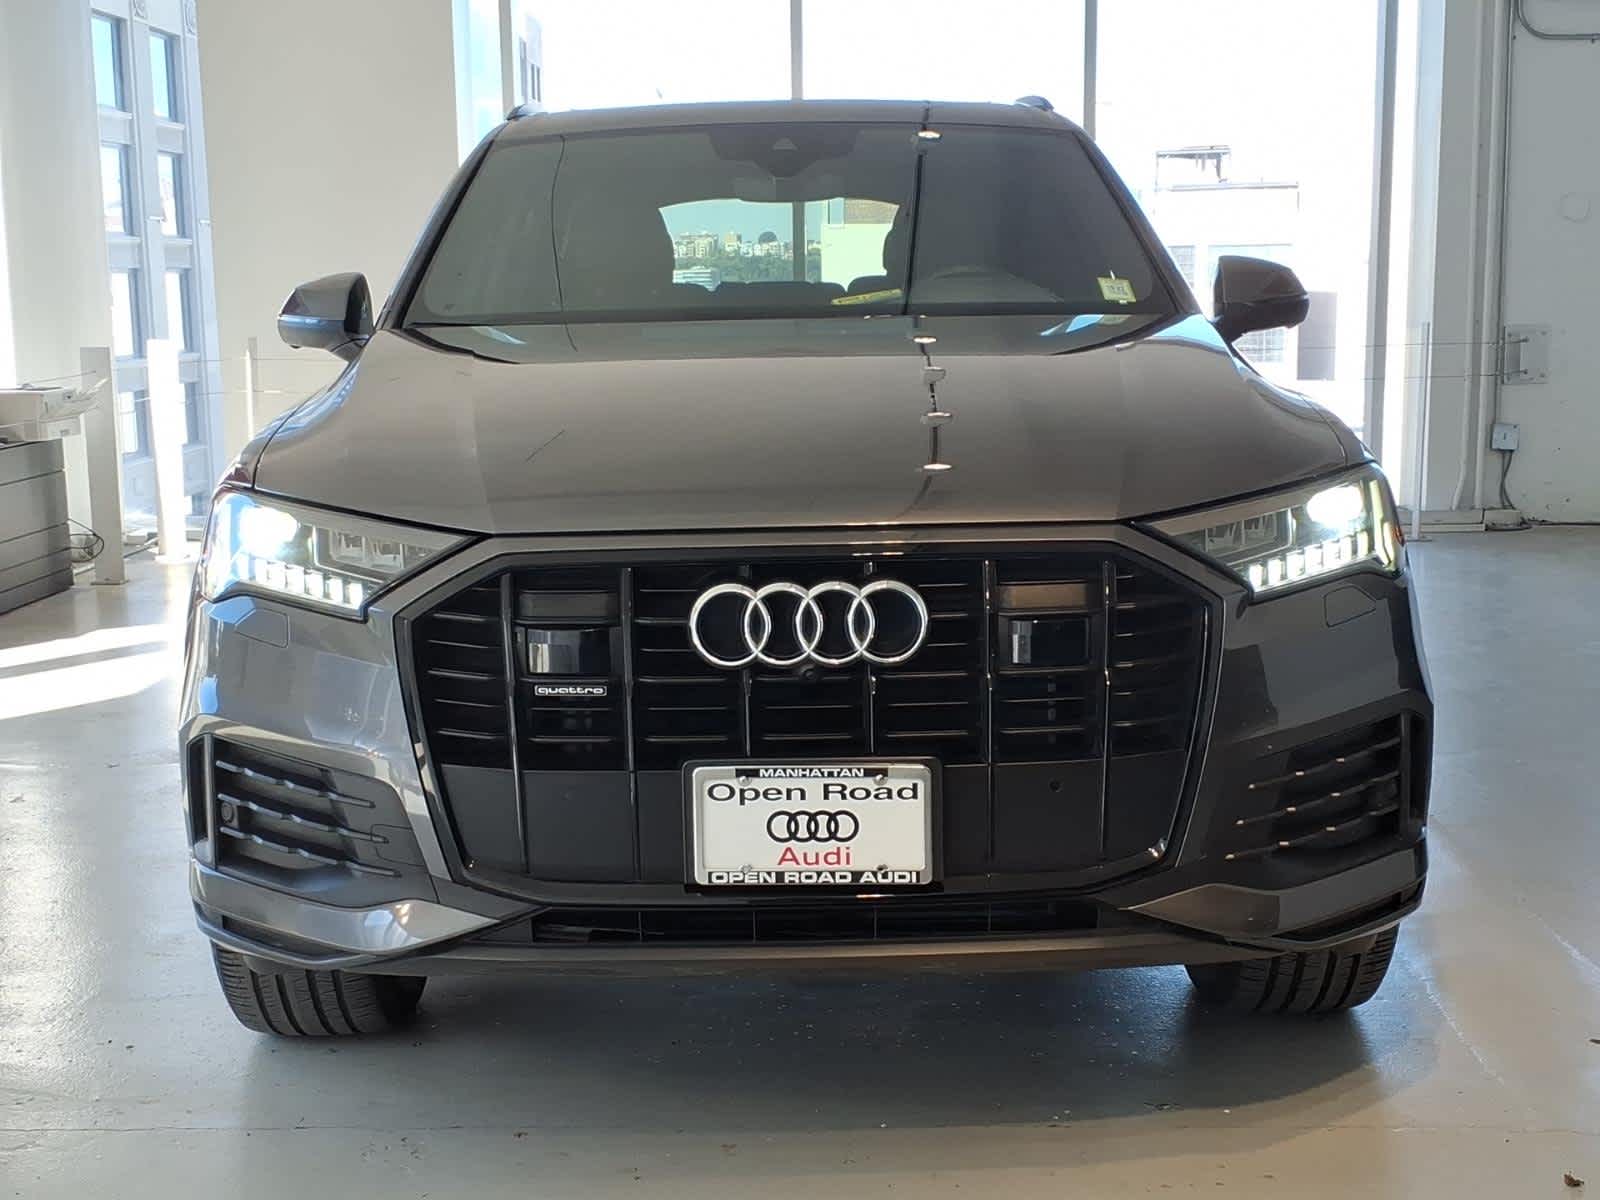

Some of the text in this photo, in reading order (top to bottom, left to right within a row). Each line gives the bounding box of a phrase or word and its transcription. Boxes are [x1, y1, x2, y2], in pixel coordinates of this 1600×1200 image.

[538, 687, 604, 696] quattro
[759, 768, 864, 778] MANHATTAN
[707, 782, 919, 806] Open Road
[777, 846, 852, 866] Audi
[711, 871, 918, 884] OPEN ROAD AUDI
